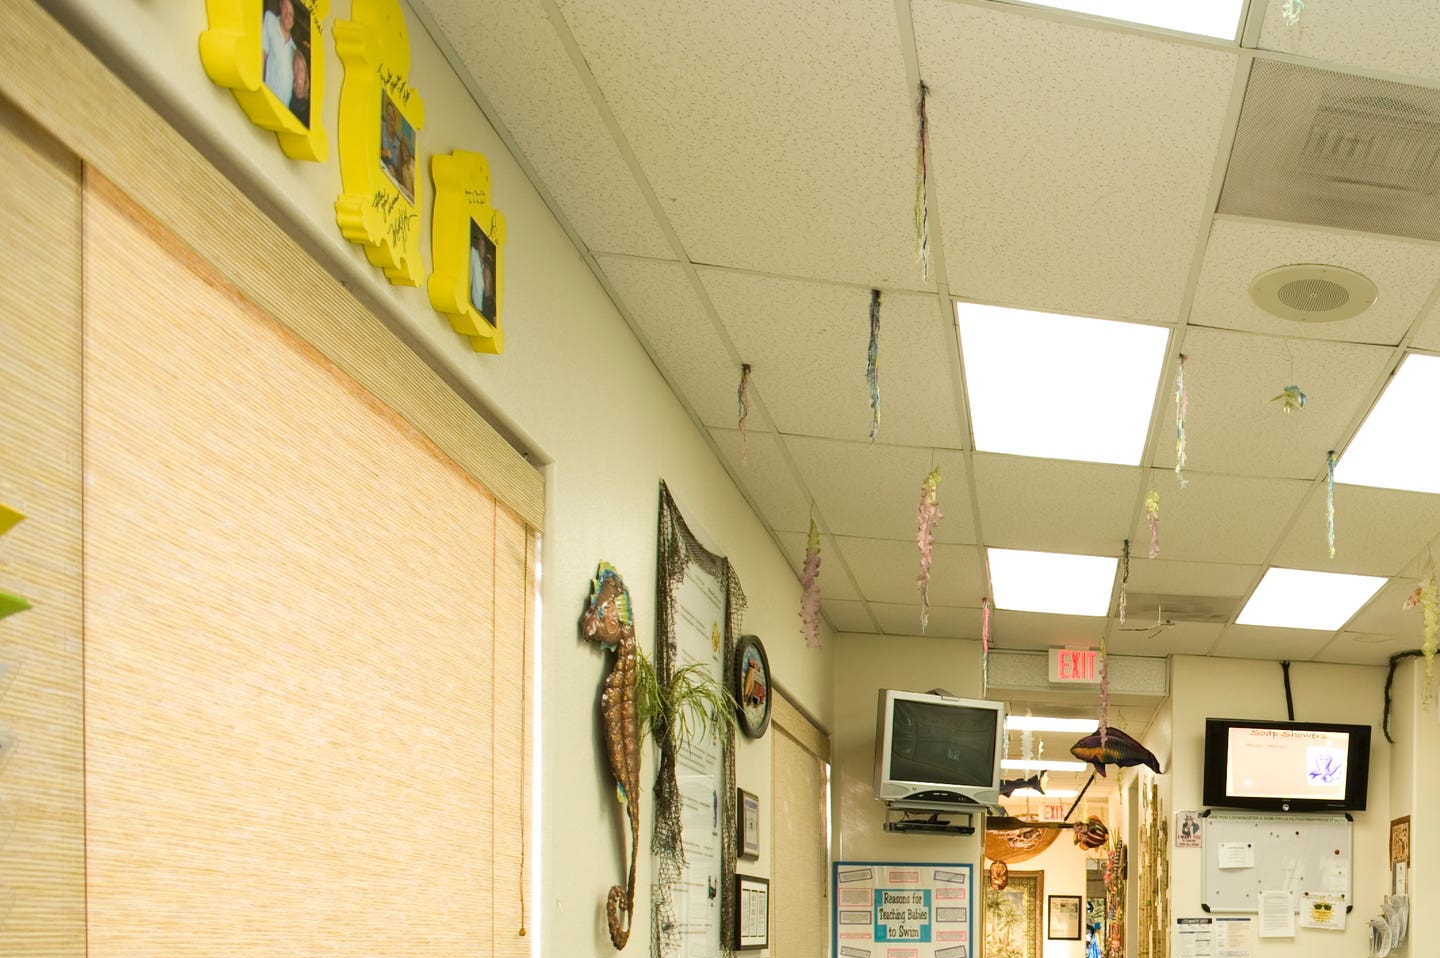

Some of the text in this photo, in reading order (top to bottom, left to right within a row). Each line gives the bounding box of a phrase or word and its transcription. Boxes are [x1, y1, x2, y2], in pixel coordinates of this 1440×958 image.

[1059, 651, 1096, 680] EXIT
[1250, 730, 1278, 739] Soap
[1044, 805, 1064, 820] EXIT
[884, 892, 922, 904] Reasons for
[879, 908, 927, 924] Teaching Babies
[889, 925, 919, 938] to Swim
